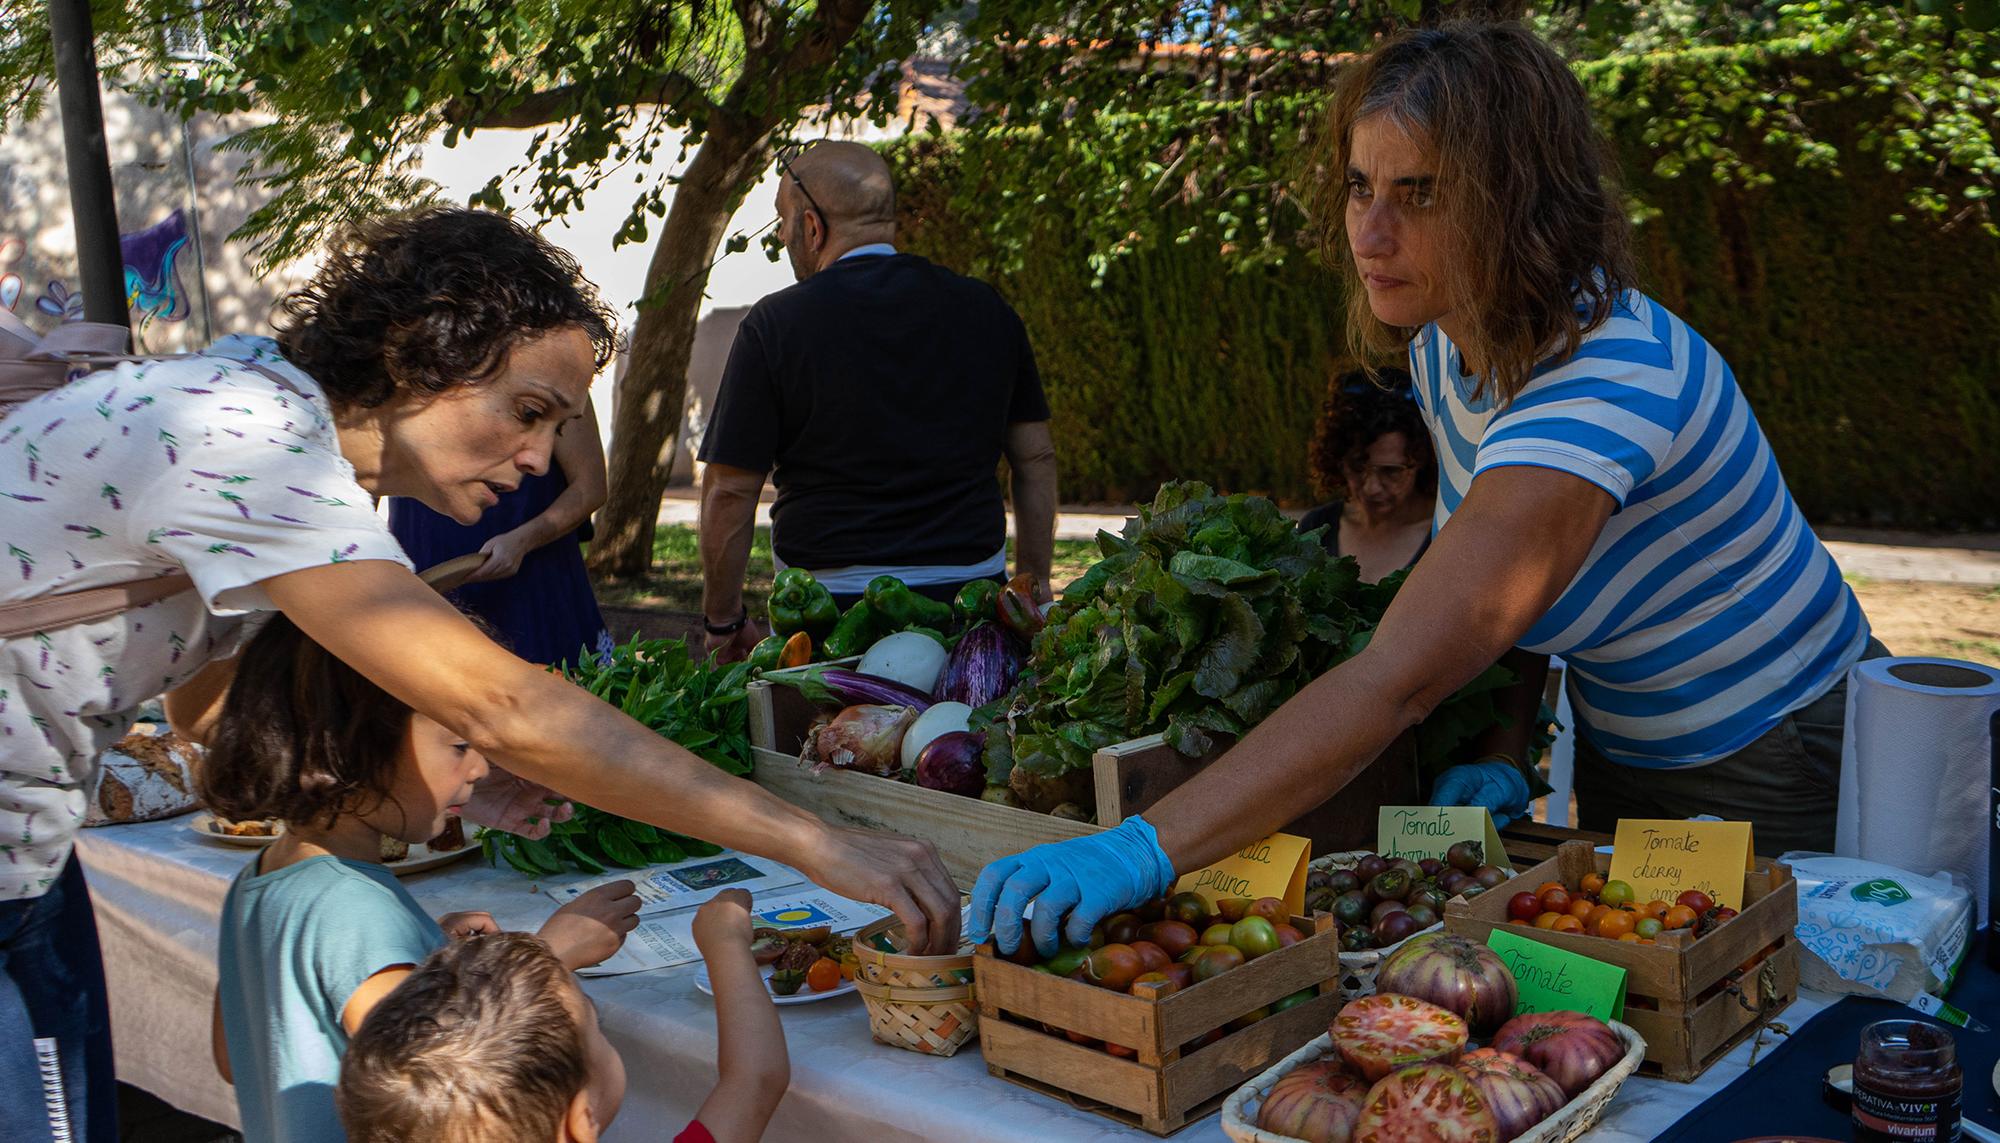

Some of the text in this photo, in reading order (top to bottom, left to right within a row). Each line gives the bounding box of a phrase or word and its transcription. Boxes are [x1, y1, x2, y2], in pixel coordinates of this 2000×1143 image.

[1394, 808, 1455, 836] Tomate
[1642, 829, 1701, 853] Tomate
[1193, 869, 1252, 898] pruna
[1504, 948, 1573, 995] Tomate
[1888, 1124, 1935, 1137] vivarium
